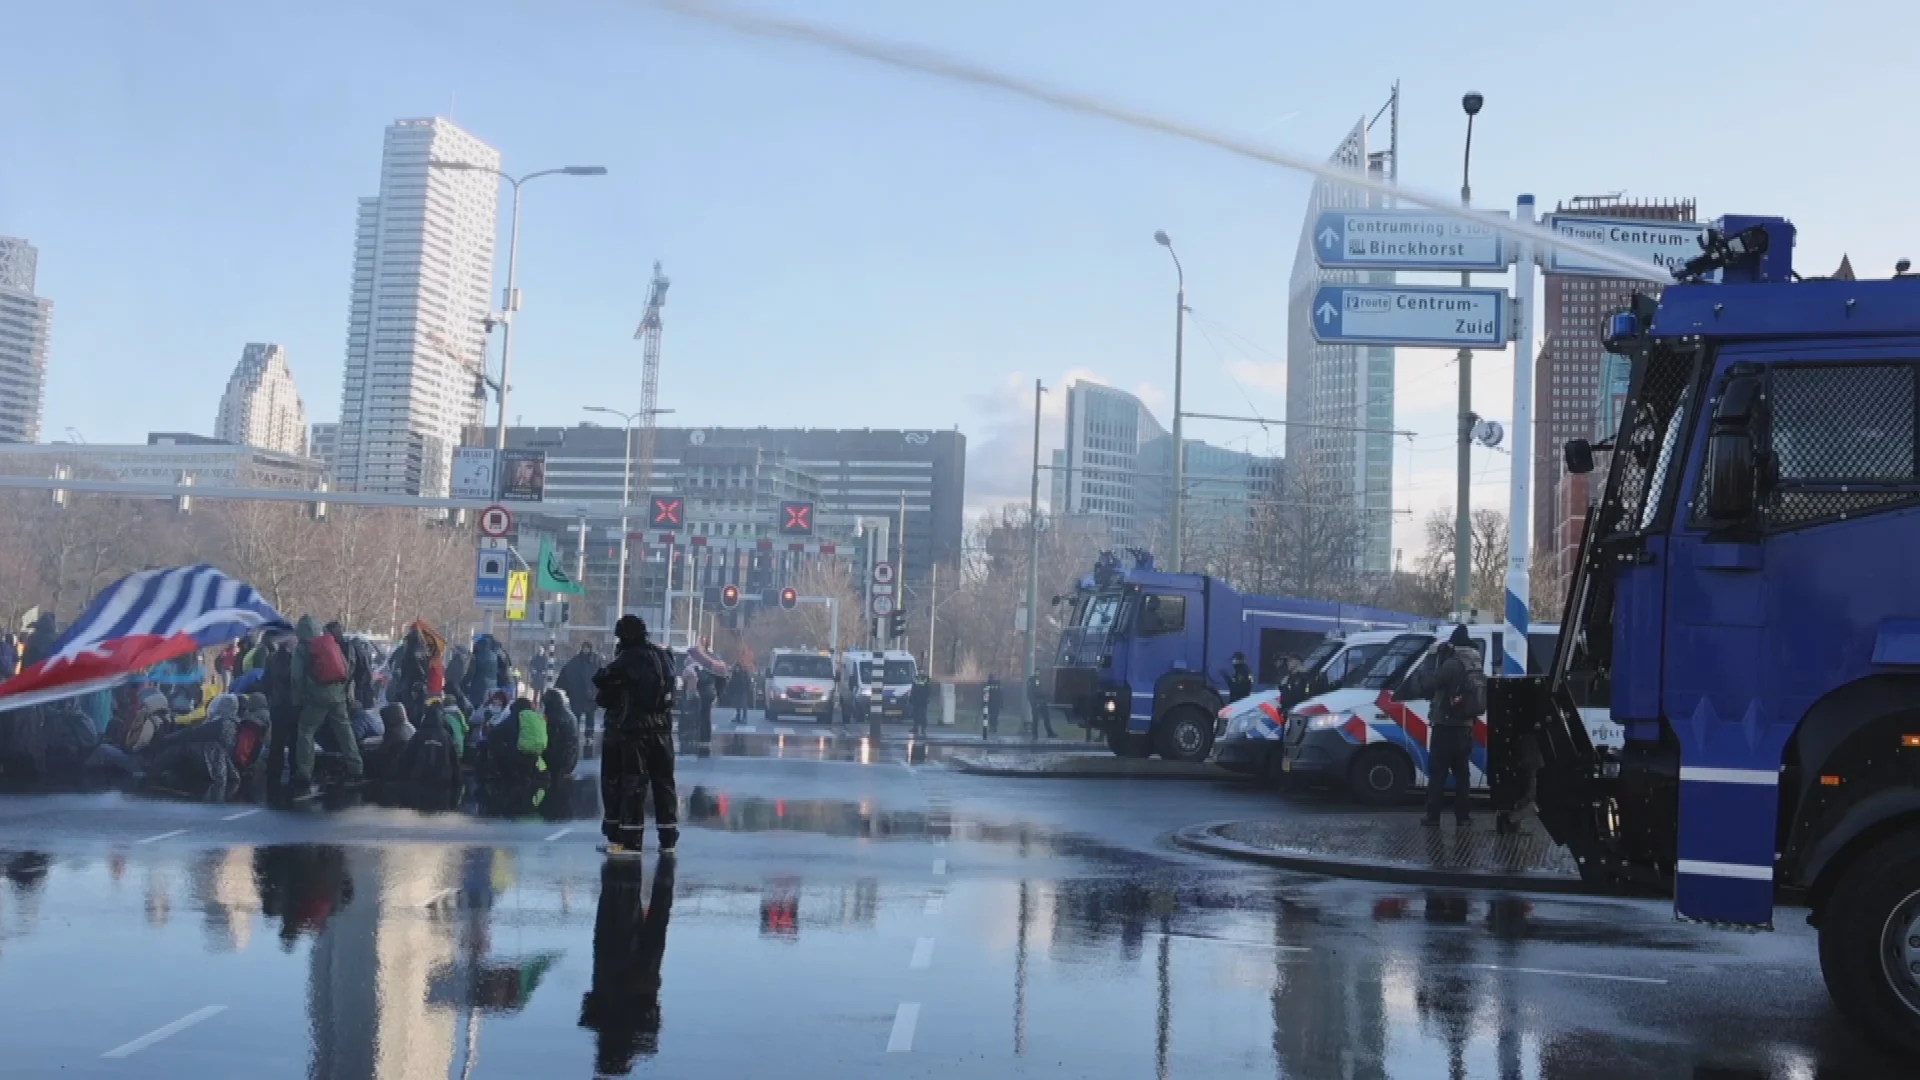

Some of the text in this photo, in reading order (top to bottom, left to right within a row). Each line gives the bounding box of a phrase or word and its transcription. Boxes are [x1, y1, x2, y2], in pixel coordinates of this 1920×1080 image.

[1347, 218, 1444, 237] Centrumring
[1575, 228, 1603, 240] route
[1610, 228, 1690, 246] Centrum-
[1370, 240, 1464, 256] Binckhorst
[1361, 298, 1388, 309] route
[1397, 294, 1479, 311] Centrum-
[1455, 319, 1493, 334] Zuid
